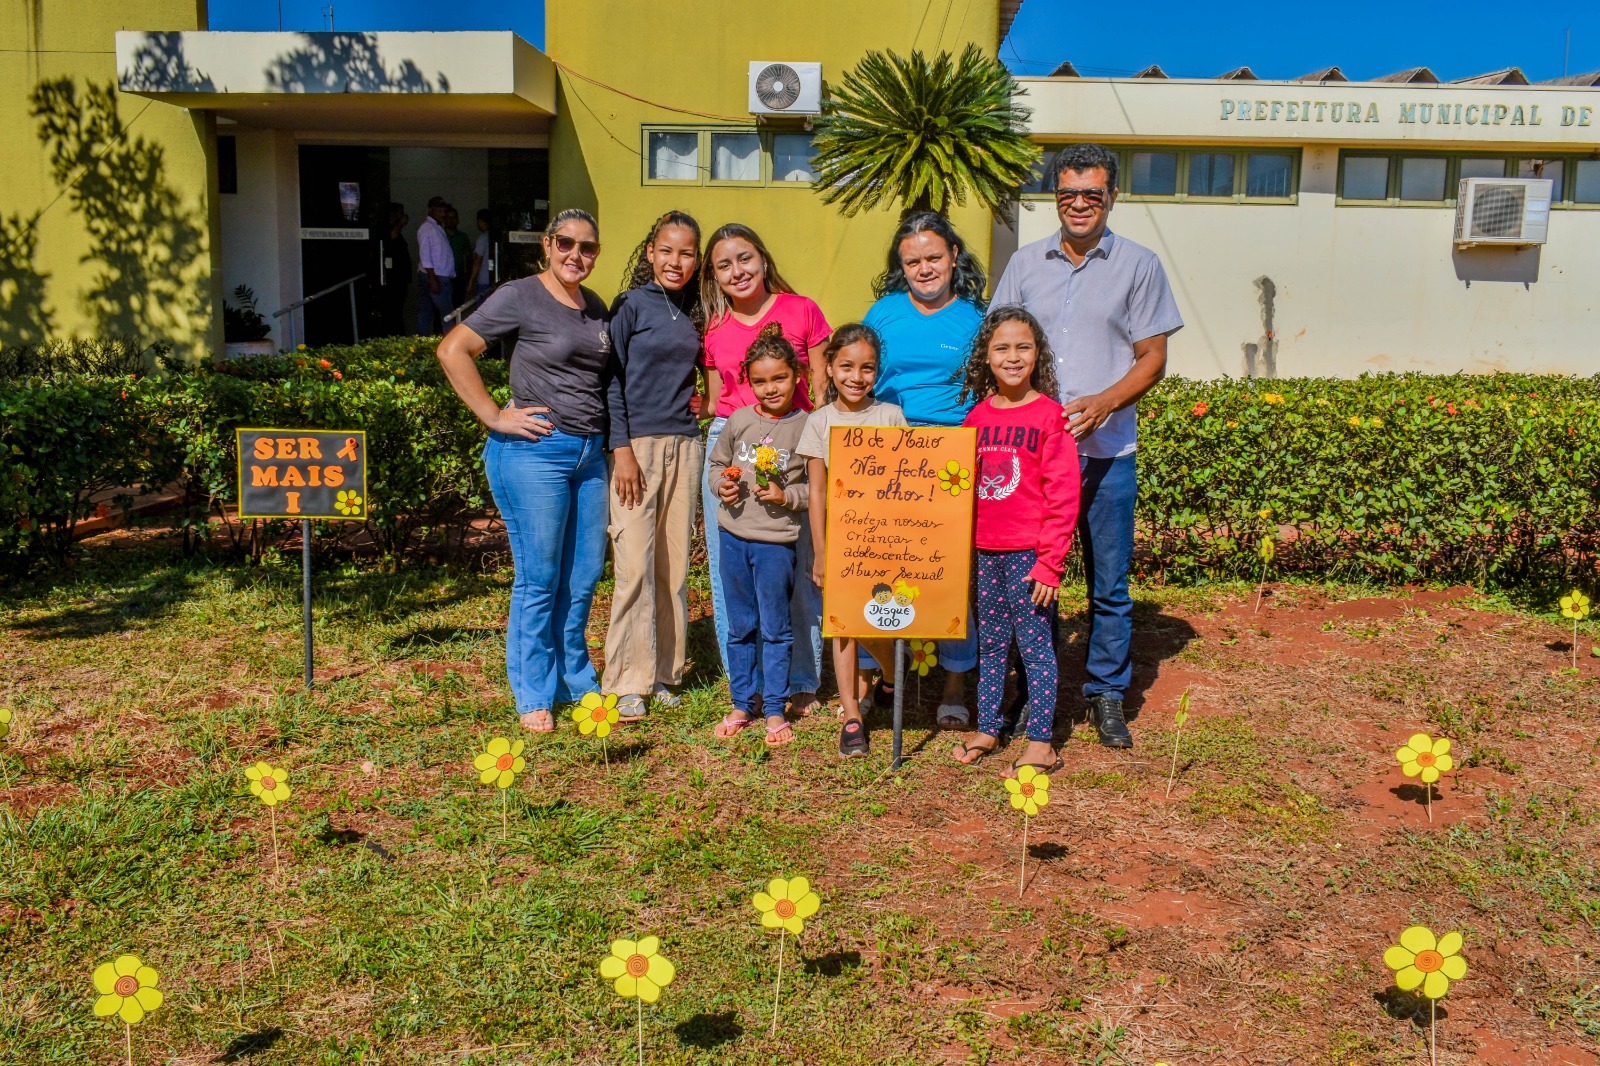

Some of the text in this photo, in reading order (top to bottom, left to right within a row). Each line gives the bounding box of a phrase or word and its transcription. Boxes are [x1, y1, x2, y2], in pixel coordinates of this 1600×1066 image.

[1219, 98, 1593, 127] PREFEITURA MUNICIPAL DE
[253, 437, 323, 460] SER
[843, 427, 945, 452] 18 de Maio
[977, 426, 1040, 453] ALIBU
[977, 446, 998, 454] ENNIS
[251, 465, 345, 488] MAIS
[850, 454, 937, 485] Não feche
[847, 488, 865, 499] os
[840, 509, 944, 533] Proteja nossas
[920, 535, 928, 545] e
[843, 545, 924, 562] adolescentes
[841, 561, 891, 579] Abuso
[877, 618, 901, 627] 100
